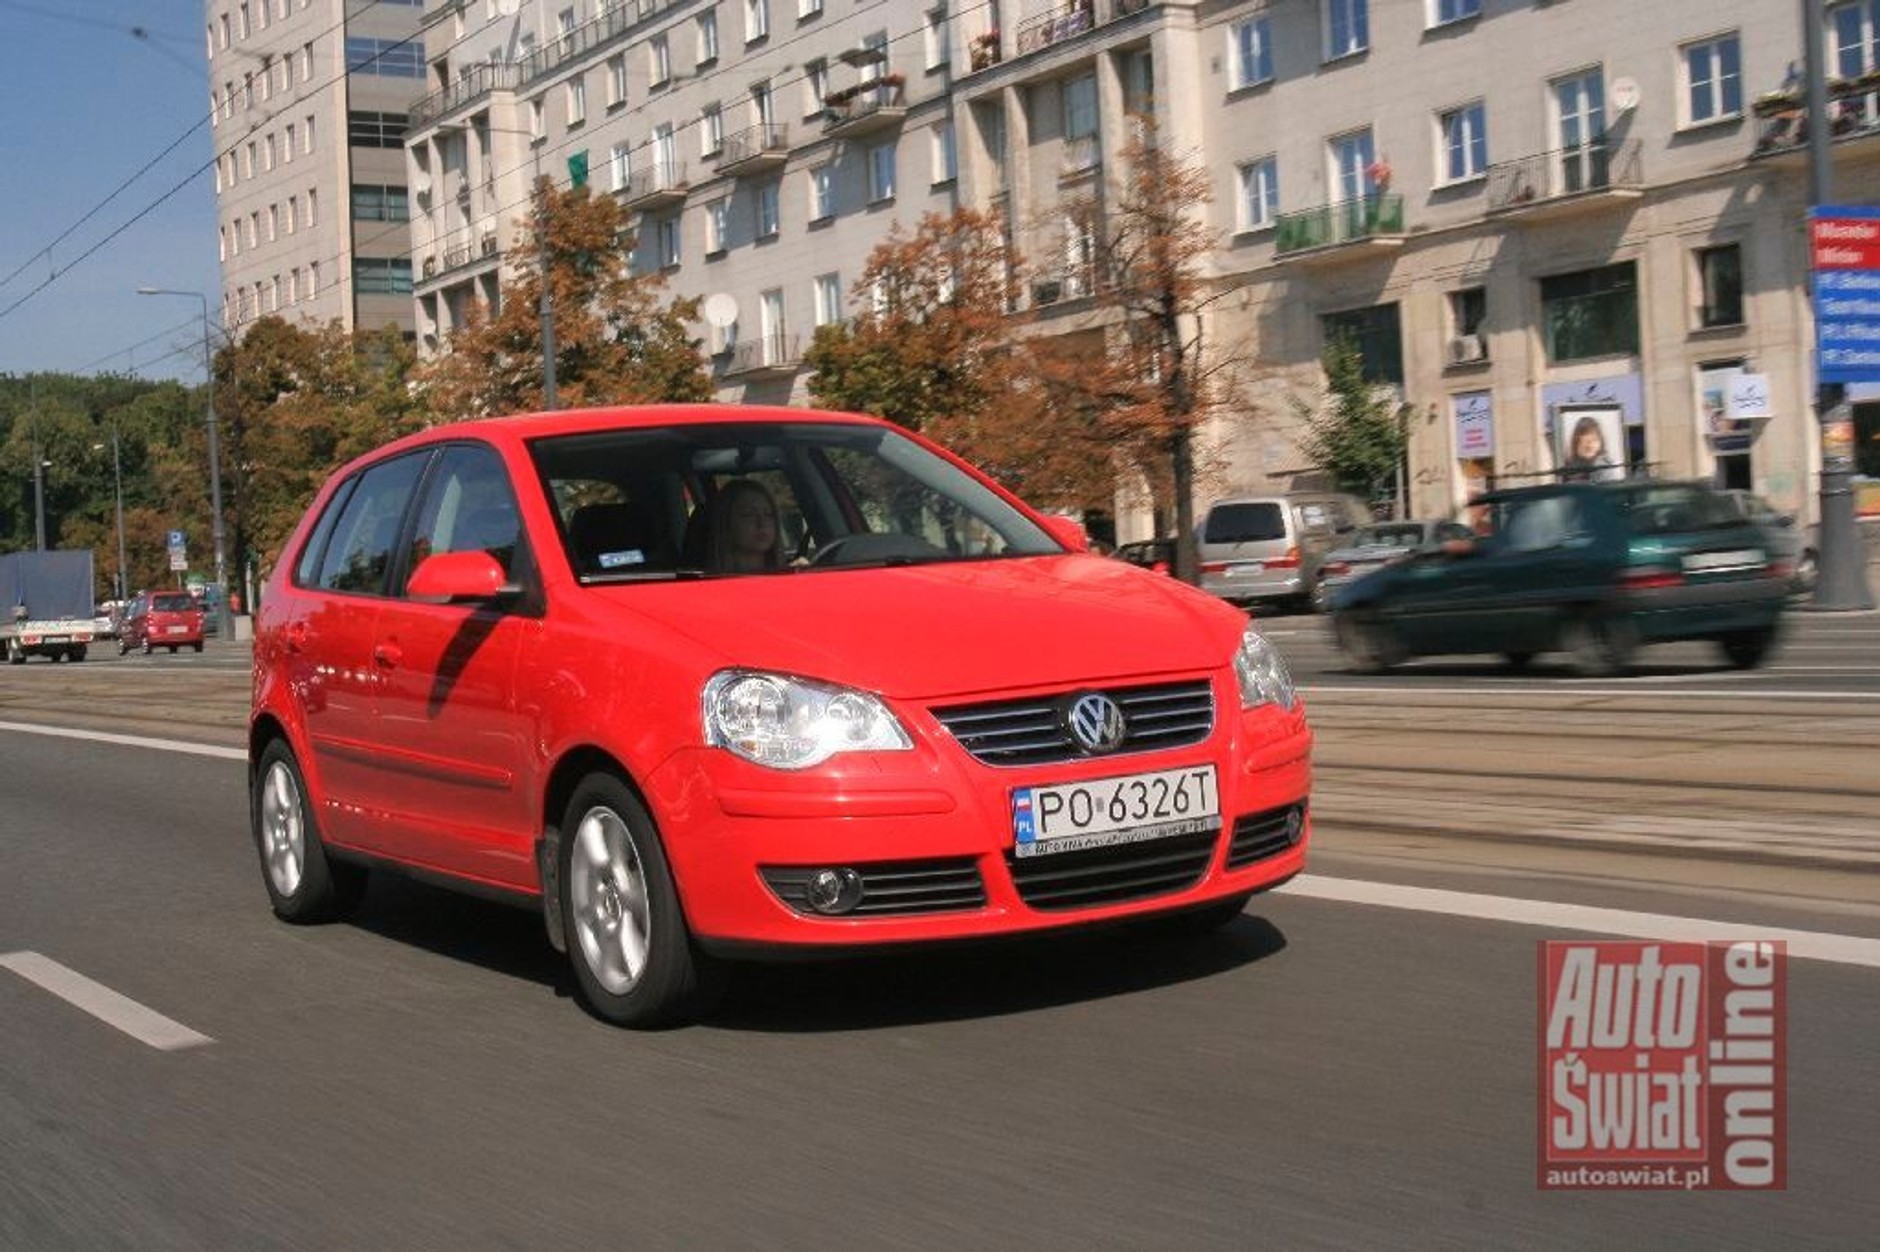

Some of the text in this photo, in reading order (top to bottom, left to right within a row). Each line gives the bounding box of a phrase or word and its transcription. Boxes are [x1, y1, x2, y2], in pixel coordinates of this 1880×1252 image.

[1038, 771, 1210, 833] PO 6326T
[1018, 818, 1032, 832] PL
